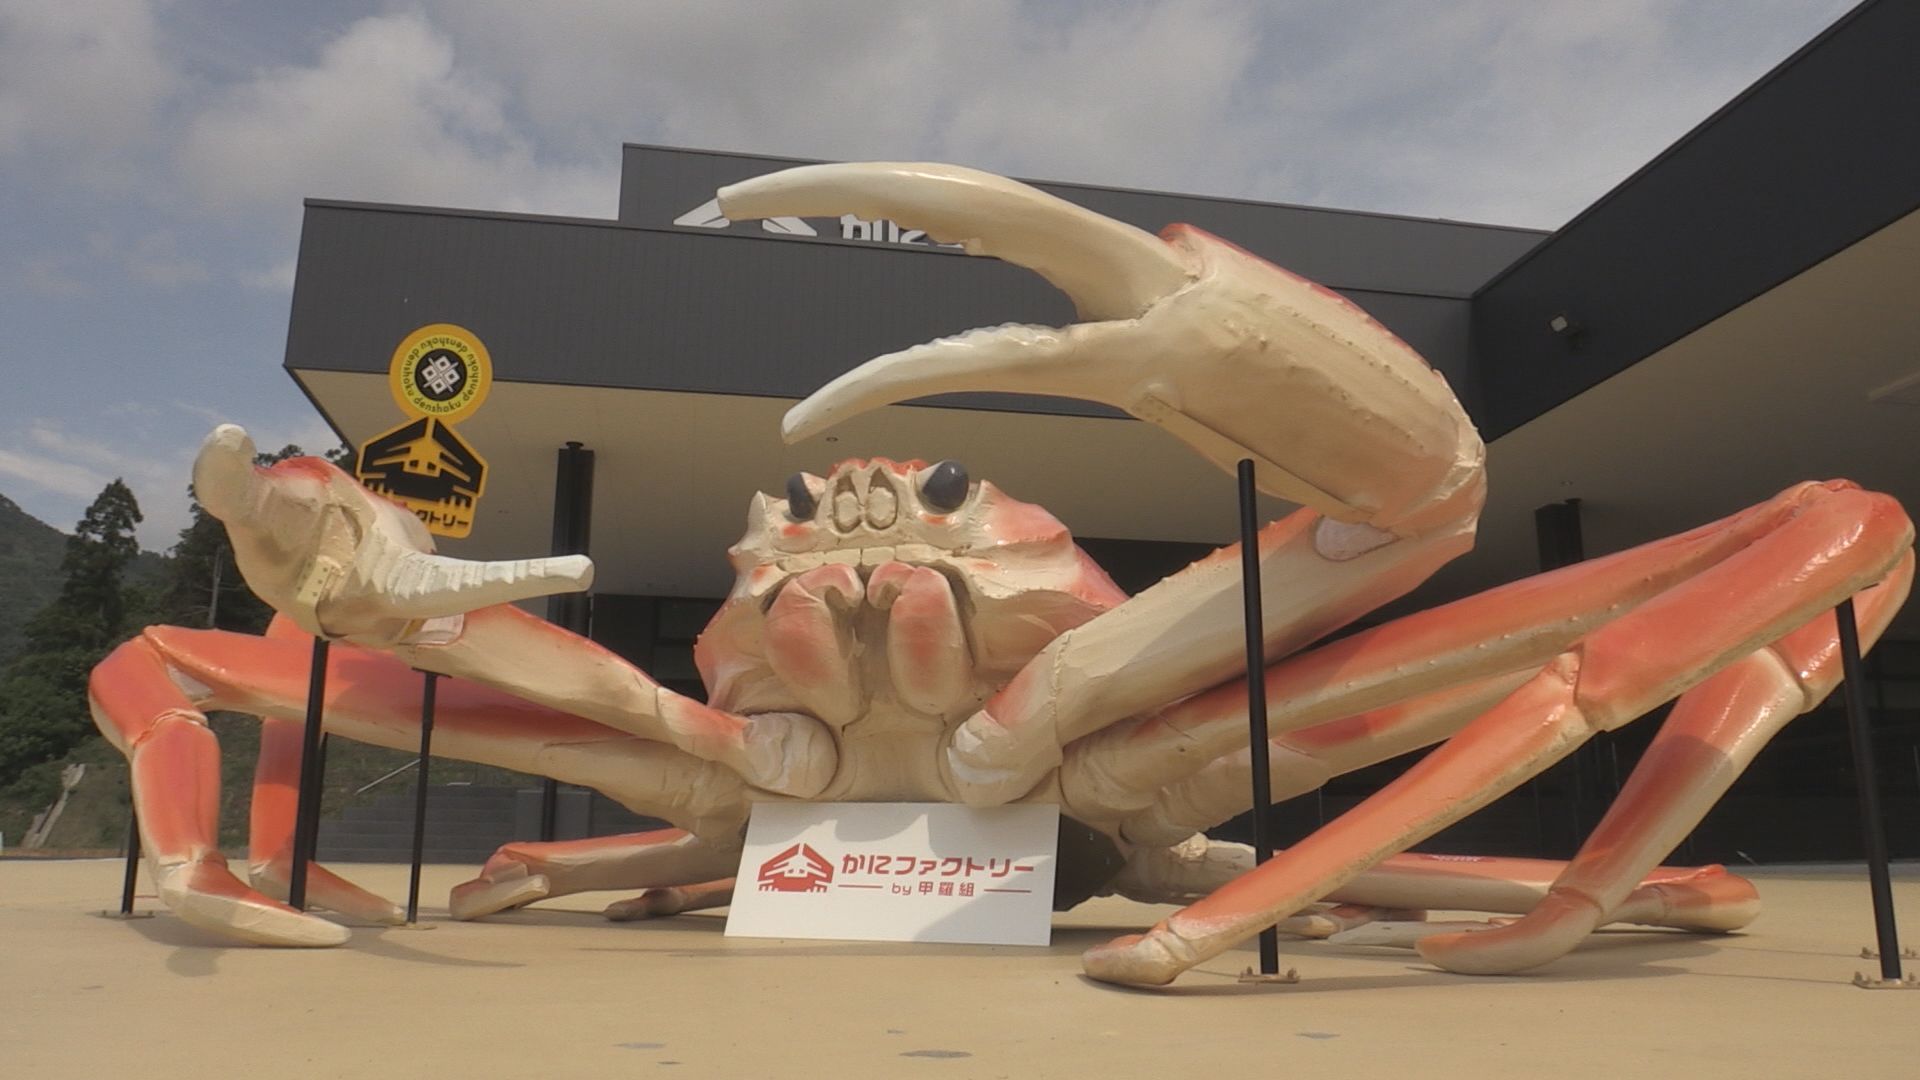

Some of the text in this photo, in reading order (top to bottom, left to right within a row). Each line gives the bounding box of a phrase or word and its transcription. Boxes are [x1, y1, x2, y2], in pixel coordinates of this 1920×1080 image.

[420, 337, 468, 353] denshoku
[403, 348, 420, 396] denshoku
[462, 353, 480, 401] denshoku
[414, 396, 461, 413] denshoku
[841, 853, 1035, 878] かにファクトリー
[891, 881, 975, 898] by 甲羅組
